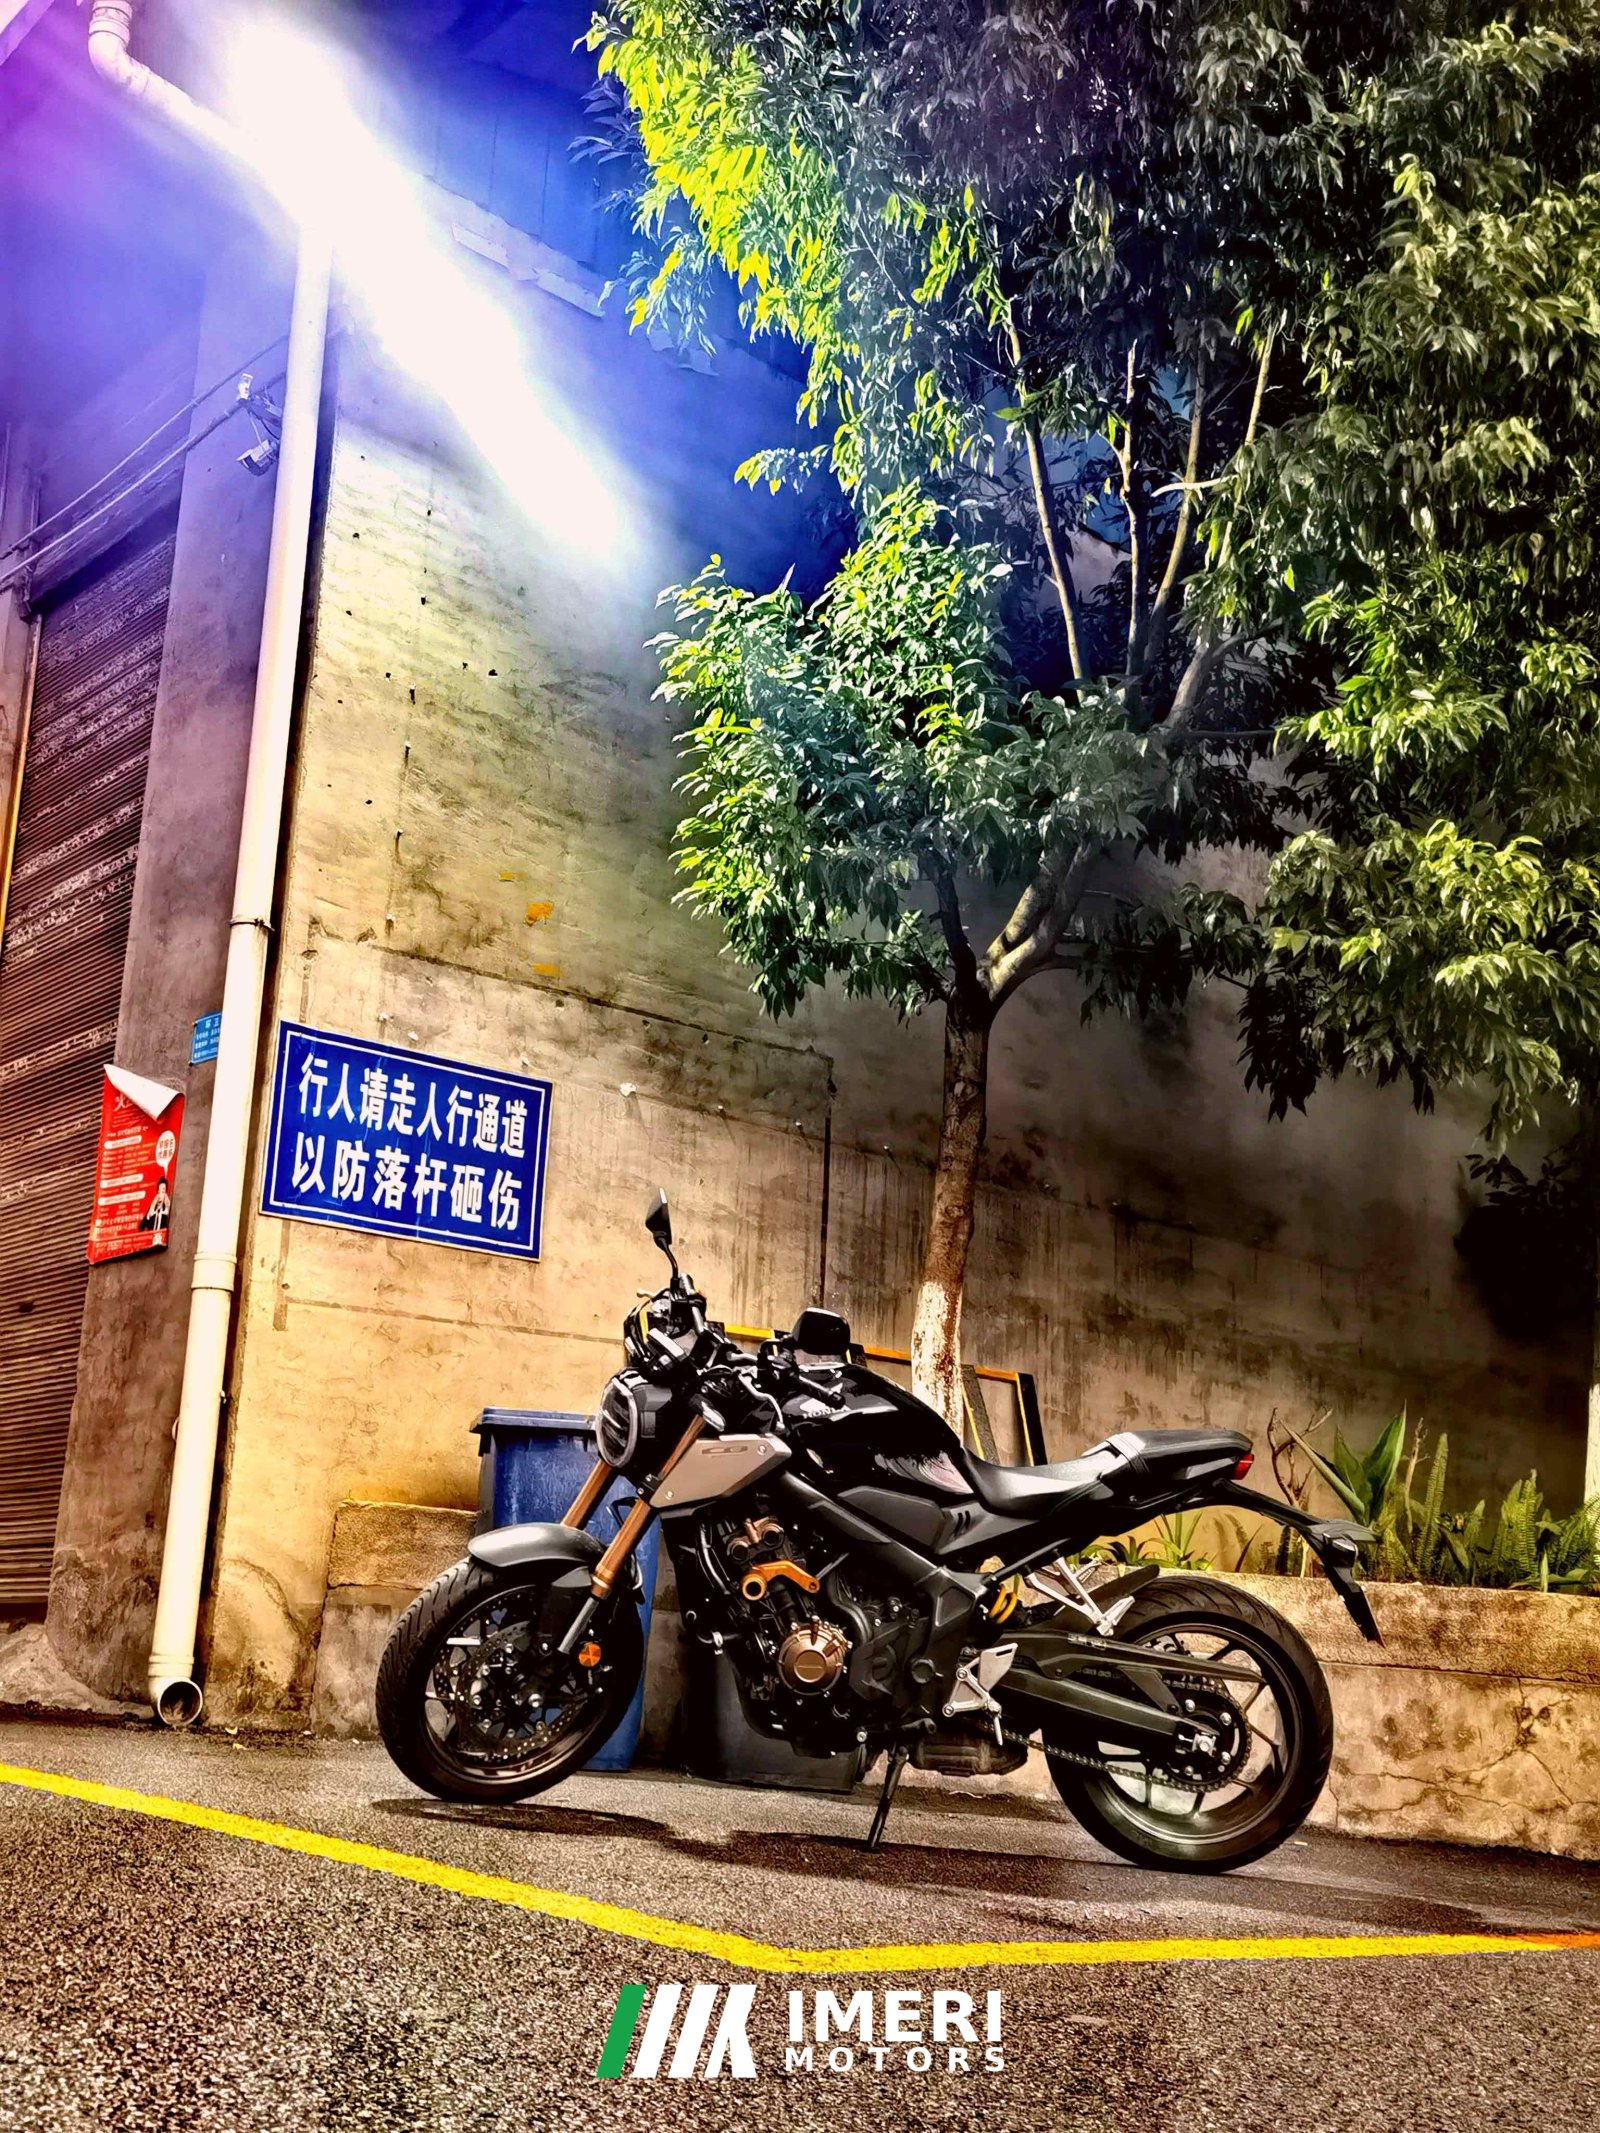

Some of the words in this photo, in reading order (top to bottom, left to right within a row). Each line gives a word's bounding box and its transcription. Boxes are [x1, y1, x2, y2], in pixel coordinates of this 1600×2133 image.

[299, 1052, 527, 1158] 行人请走人行通道
[291, 1132, 522, 1231] 以防落杆砸伤
